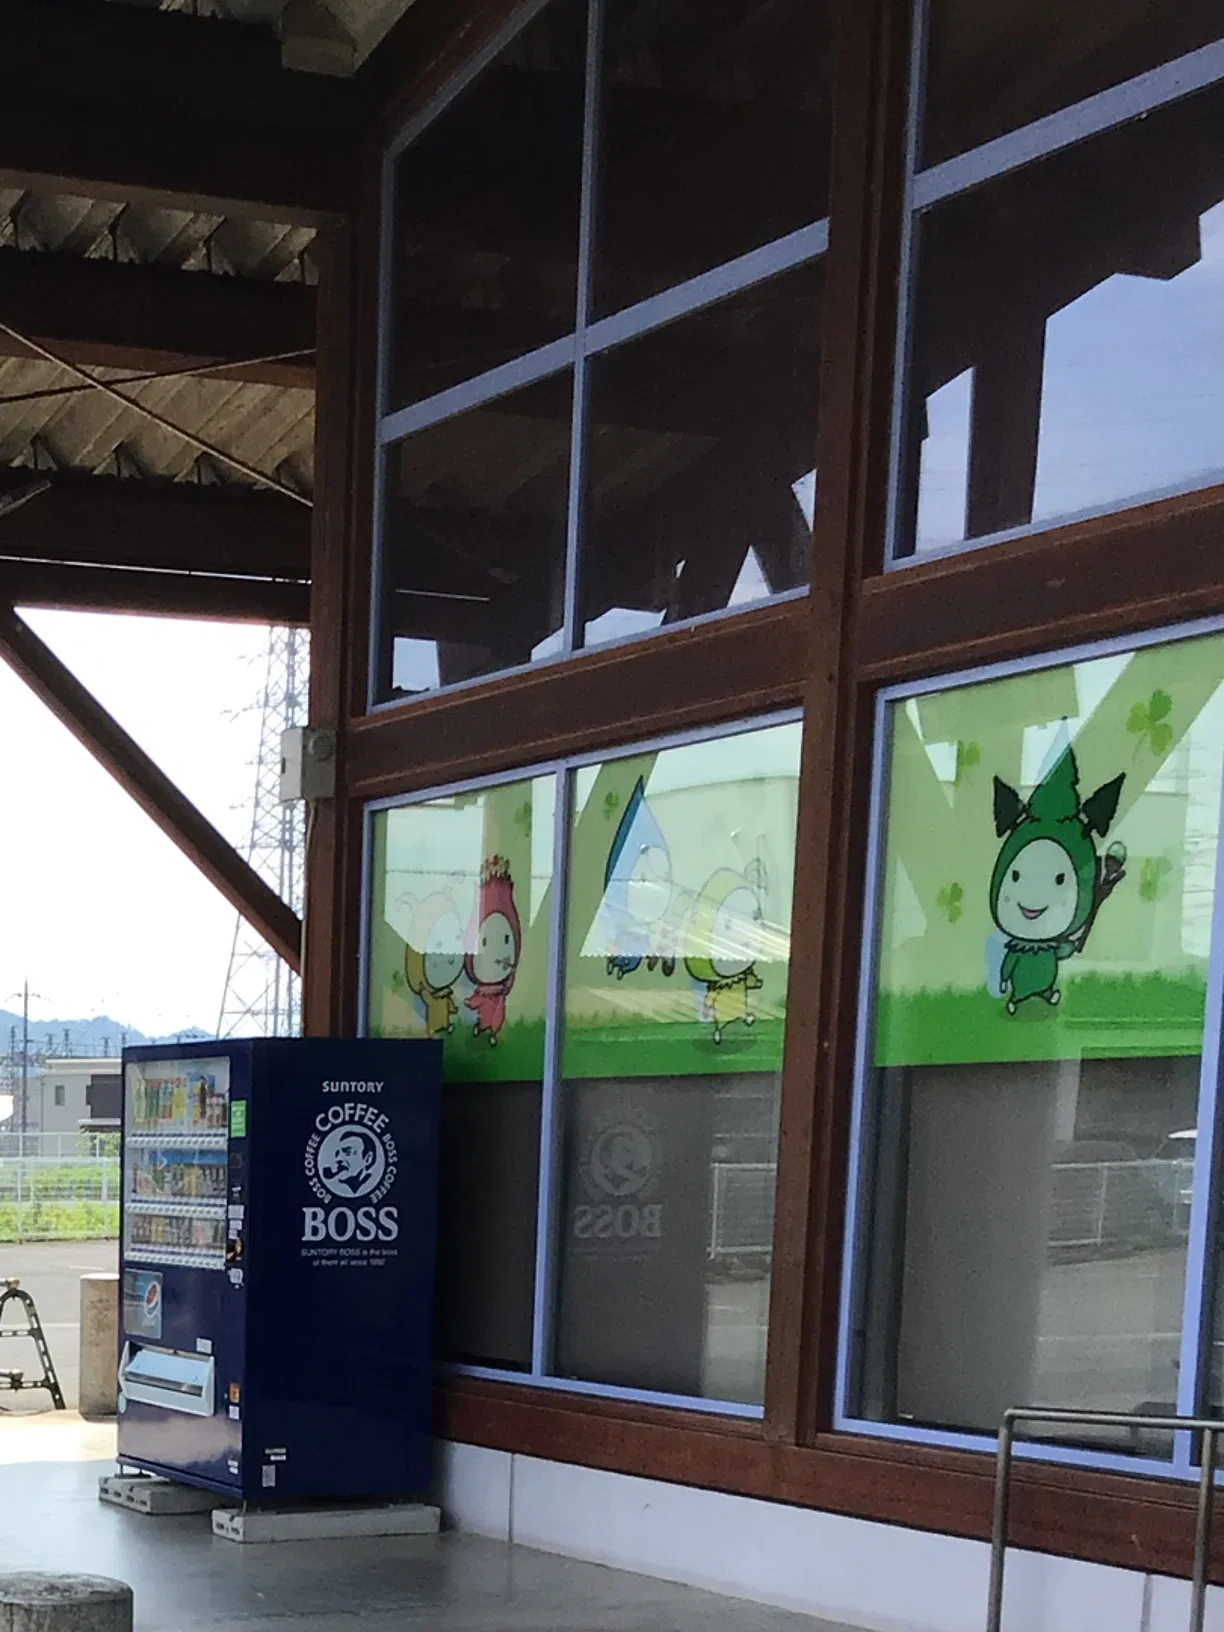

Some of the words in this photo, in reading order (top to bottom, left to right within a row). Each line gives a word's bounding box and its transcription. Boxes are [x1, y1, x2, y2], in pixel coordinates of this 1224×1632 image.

[322, 1080, 384, 1093] SUNTORY
[315, 1102, 390, 1133] COFFEE
[304, 1133, 321, 1176] COFFEE
[382, 1133, 398, 1164] BOSS
[309, 1177, 333, 1204] BOSS
[370, 1166, 397, 1204] COFFEE
[301, 1207, 399, 1241] BOSS
